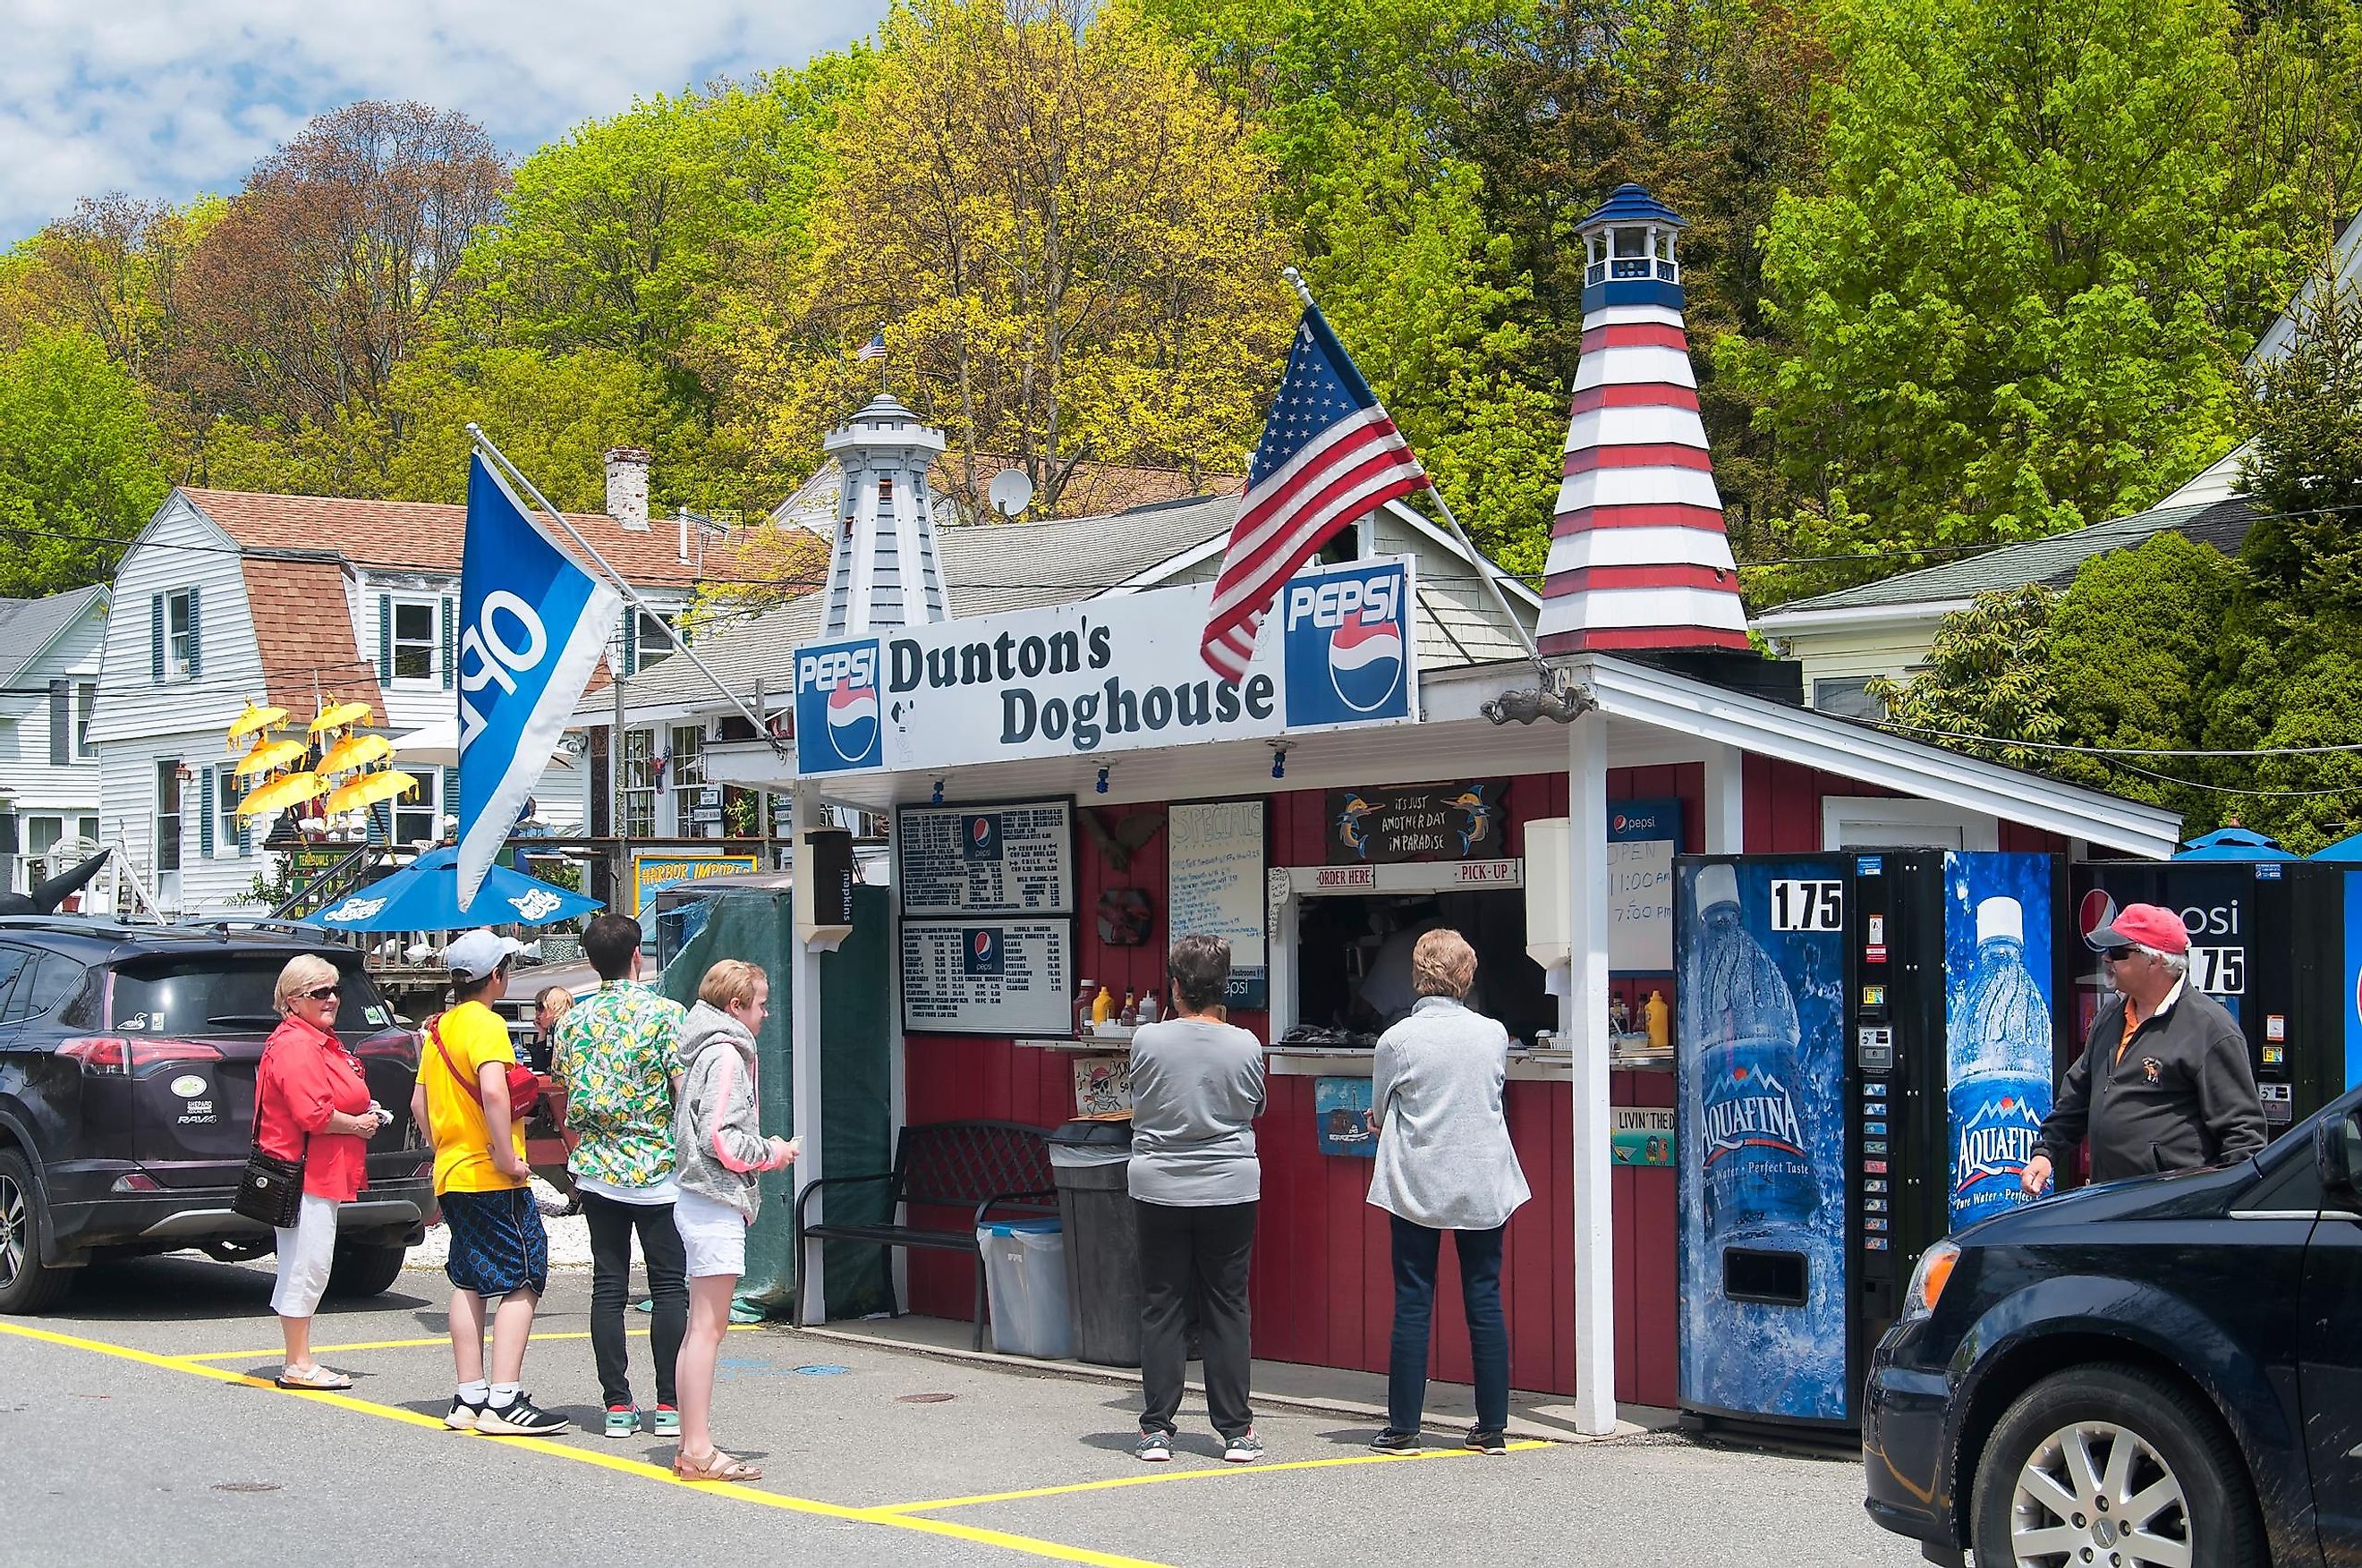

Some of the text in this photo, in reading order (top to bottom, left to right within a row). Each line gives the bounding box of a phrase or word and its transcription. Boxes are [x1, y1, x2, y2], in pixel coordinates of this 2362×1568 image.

[1287, 574, 1400, 632] PEPSI
[888, 615, 1110, 693] Dunton's
[798, 647, 877, 694] PEPSI
[1000, 674, 1275, 751] Doghouse
[1426, 811, 1447, 826] DAY
[1628, 816, 1655, 831] pepsi
[641, 863, 689, 886] HARBOR
[1319, 869, 1371, 886] ORDER HERE
[1610, 872, 1653, 897] 11:00
[842, 873, 852, 921] napkins
[1775, 883, 1841, 930] 1.75
[177, 1115, 217, 1124] RAV4
[1619, 1112, 1649, 1130] LIVIN'
[1701, 1089, 1804, 1166] AQUAFINA
[1956, 1123, 2043, 1190] AQUAFIN
[1716, 1166, 1738, 1182] Water
[1748, 1161, 1782, 1175] Perfect
[1786, 1161, 1809, 1174] Taste
[1956, 1198, 1971, 1210] Pure
[1973, 1191, 1997, 1204] Water
